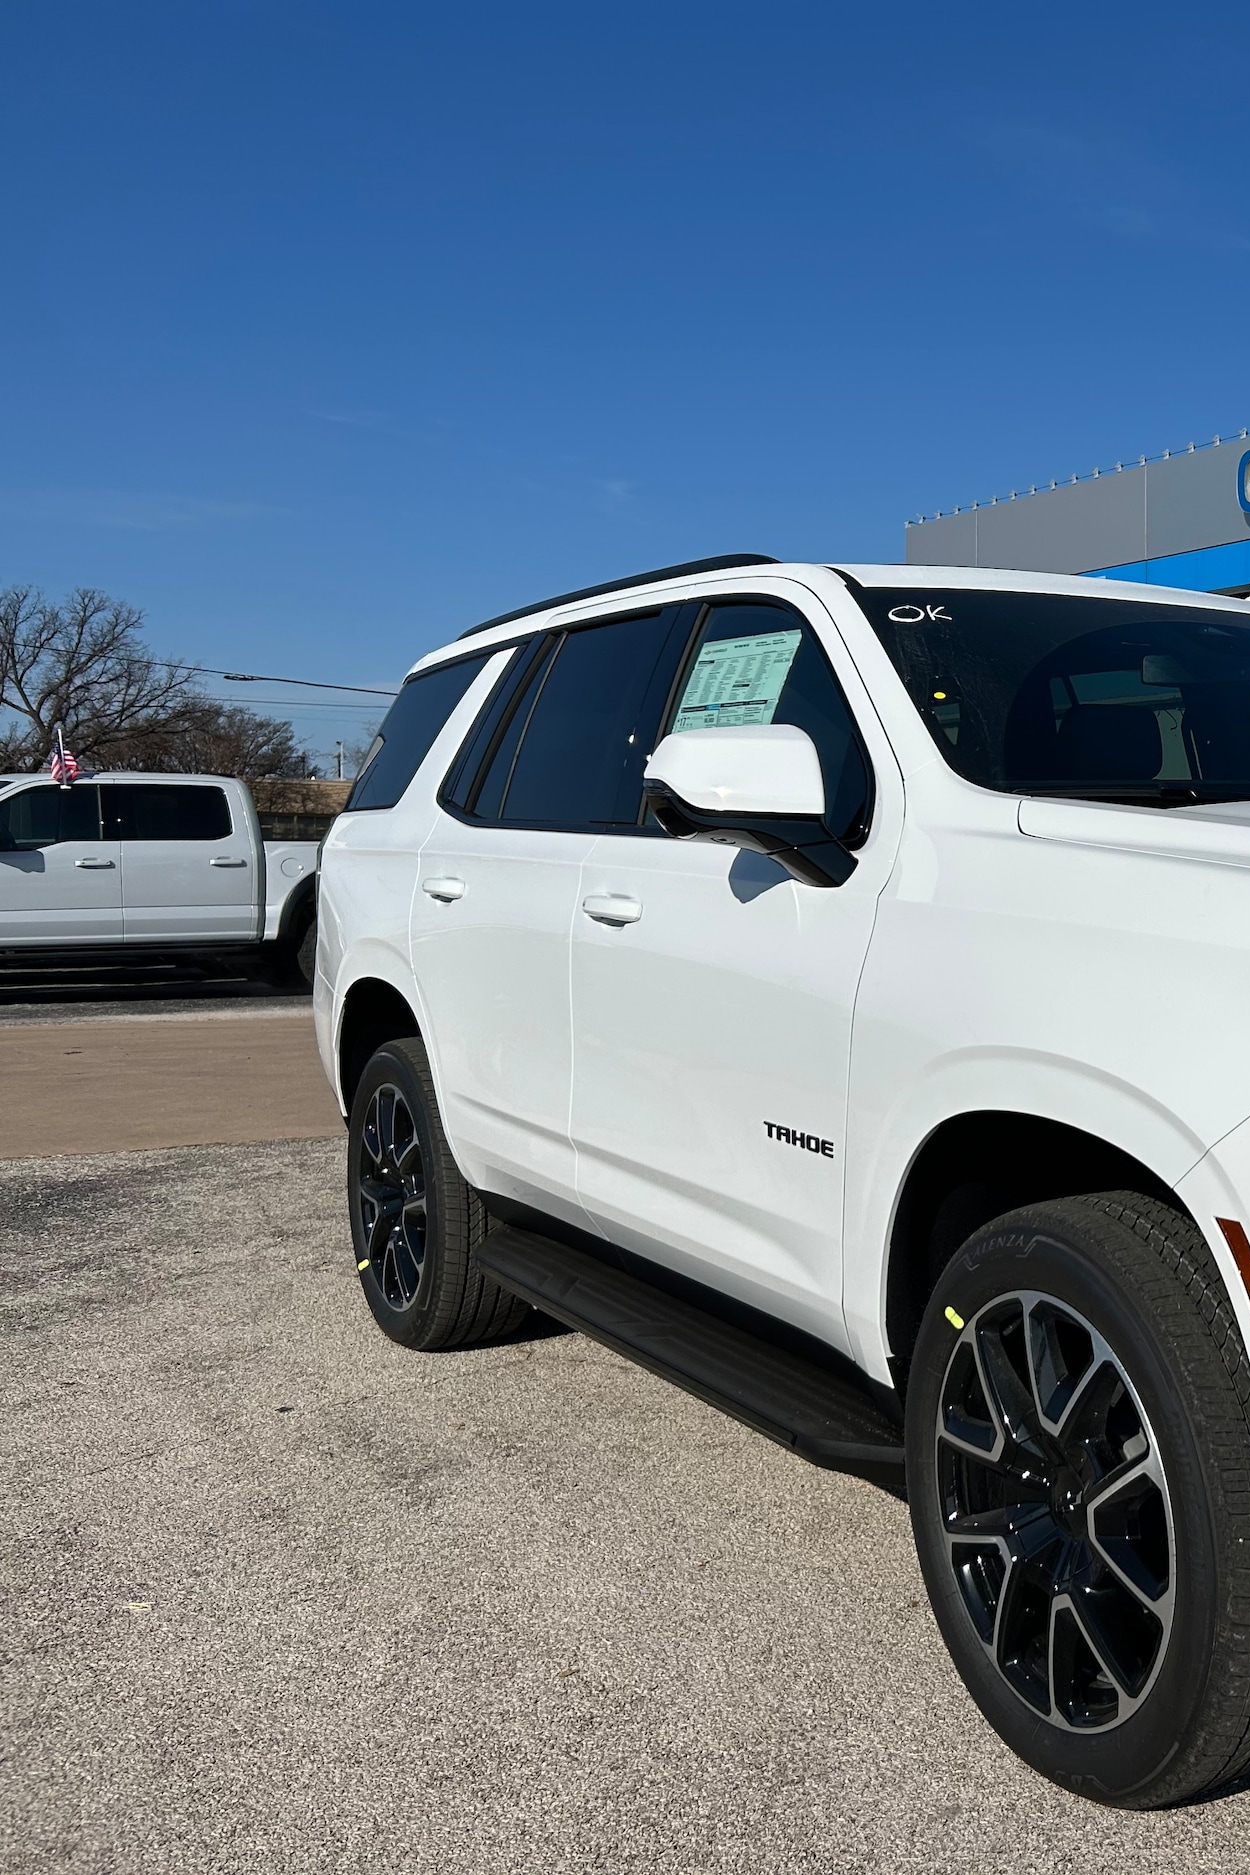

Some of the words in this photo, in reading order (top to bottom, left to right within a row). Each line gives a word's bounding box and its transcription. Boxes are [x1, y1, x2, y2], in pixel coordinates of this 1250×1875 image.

[888, 605, 953, 623] OK
[763, 1121, 834, 1159] TAHOE
[974, 1234, 1024, 1257] ALENZA
